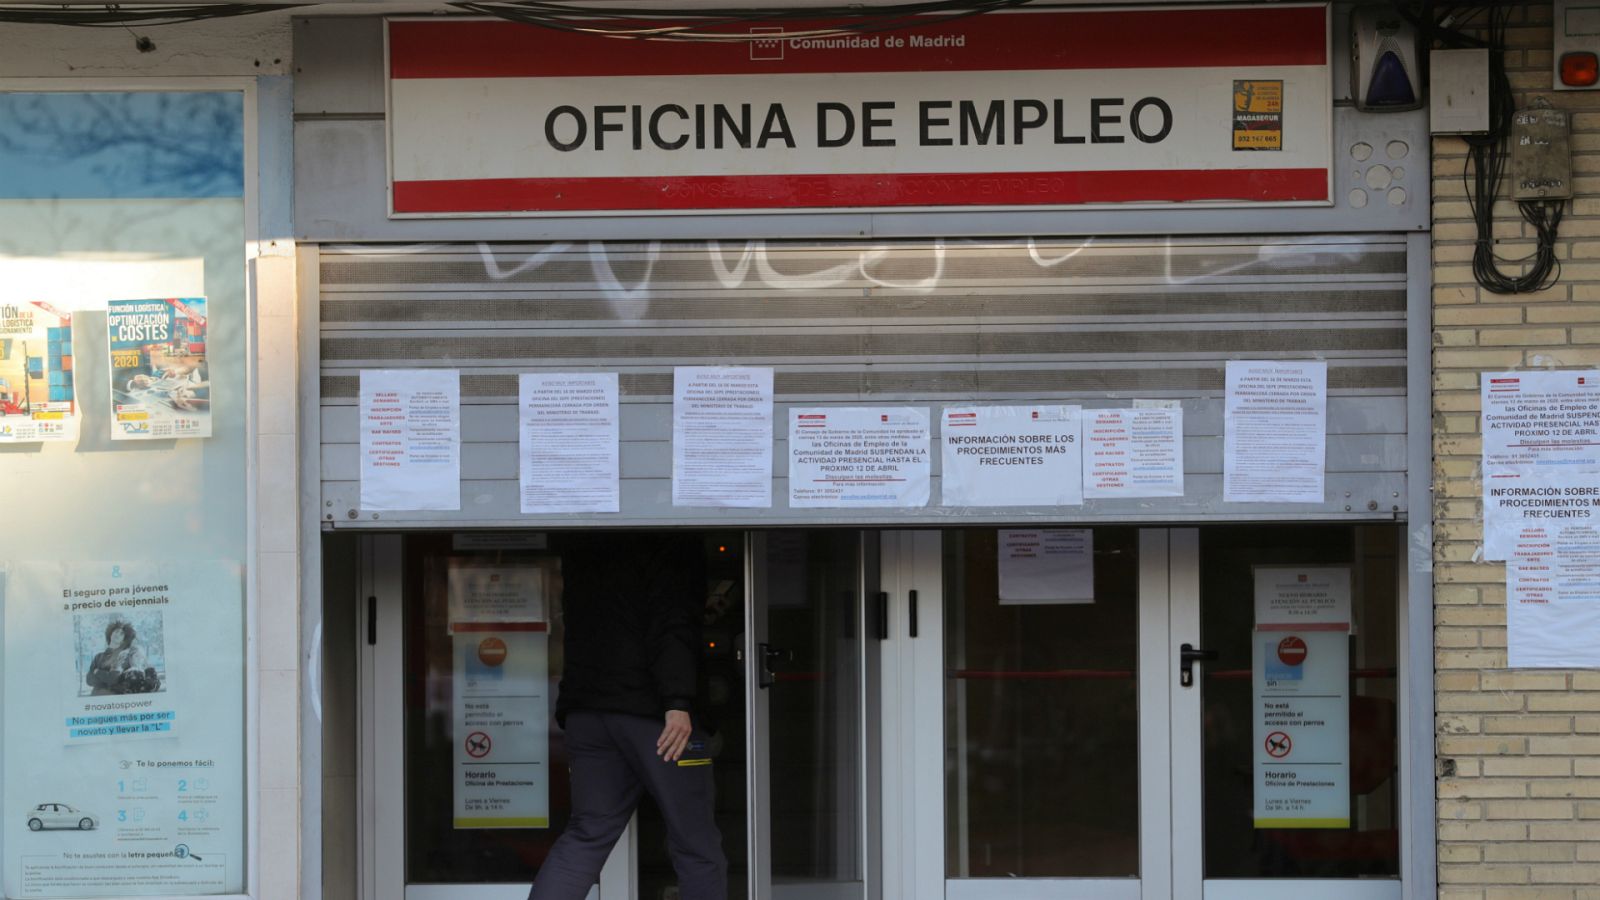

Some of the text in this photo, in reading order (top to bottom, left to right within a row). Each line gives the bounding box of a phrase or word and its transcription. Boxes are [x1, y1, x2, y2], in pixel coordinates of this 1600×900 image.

[790, 35, 966, 50] Comunidad de Madrid
[545, 95, 1174, 151] OFICINA DE EMPLEO
[1236, 114, 1279, 122] MAGASEGUR
[108, 303, 134, 313] FUNCIÓN
[134, 302, 165, 312] LOGÍSTICA
[109, 313, 169, 326] OPTIMIZACIÓN
[119, 325, 168, 341] COSTES
[114, 356, 139, 368] 2020
[1517, 404, 1547, 412] Oficinas
[1559, 404, 1587, 412] Empleo
[1486, 413, 1528, 421] Comunidad
[1540, 412, 1565, 420] Madrid
[1491, 421, 1532, 429] ACTIVIDAD
[1533, 420, 1581, 428] PRESENCIAL
[949, 434, 1075, 444] INFORMACIÓN SOBRE LOS
[863, 441, 890, 449] Empleo
[957, 445, 1042, 455] PROCEDIMIENTOS
[838, 456, 885, 464] PRESENCIAL
[980, 456, 1044, 466] FRECUENTES
[1490, 485, 1600, 496] INFORMACIÓN SOBRE
[1499, 498, 1590, 508] PROCEDIMIENTOS
[1523, 509, 1591, 518] FRECUENTES
[111, 564, 121, 579] &
[63, 584, 169, 598] El seguro para jóvenes
[63, 595, 169, 612] a precio de viejennials
[84, 699, 153, 712] #novatospower
[71, 711, 170, 727] No pagues más por ser
[78, 728, 107, 736] novato
[108, 727, 115, 735] y
[116, 725, 139, 734] llevar
[141, 724, 150, 732] la
[136, 759, 215, 769] Te lo ponemos fácil:
[465, 771, 496, 779] Horario
[1264, 771, 1296, 779] Horario
[117, 780, 125, 792] 1
[178, 779, 188, 792] 2
[117, 810, 127, 822] 3
[178, 810, 189, 822] 4
[63, 851, 73, 859] No
[107, 851, 120, 859] con
[127, 850, 145, 859] letra
